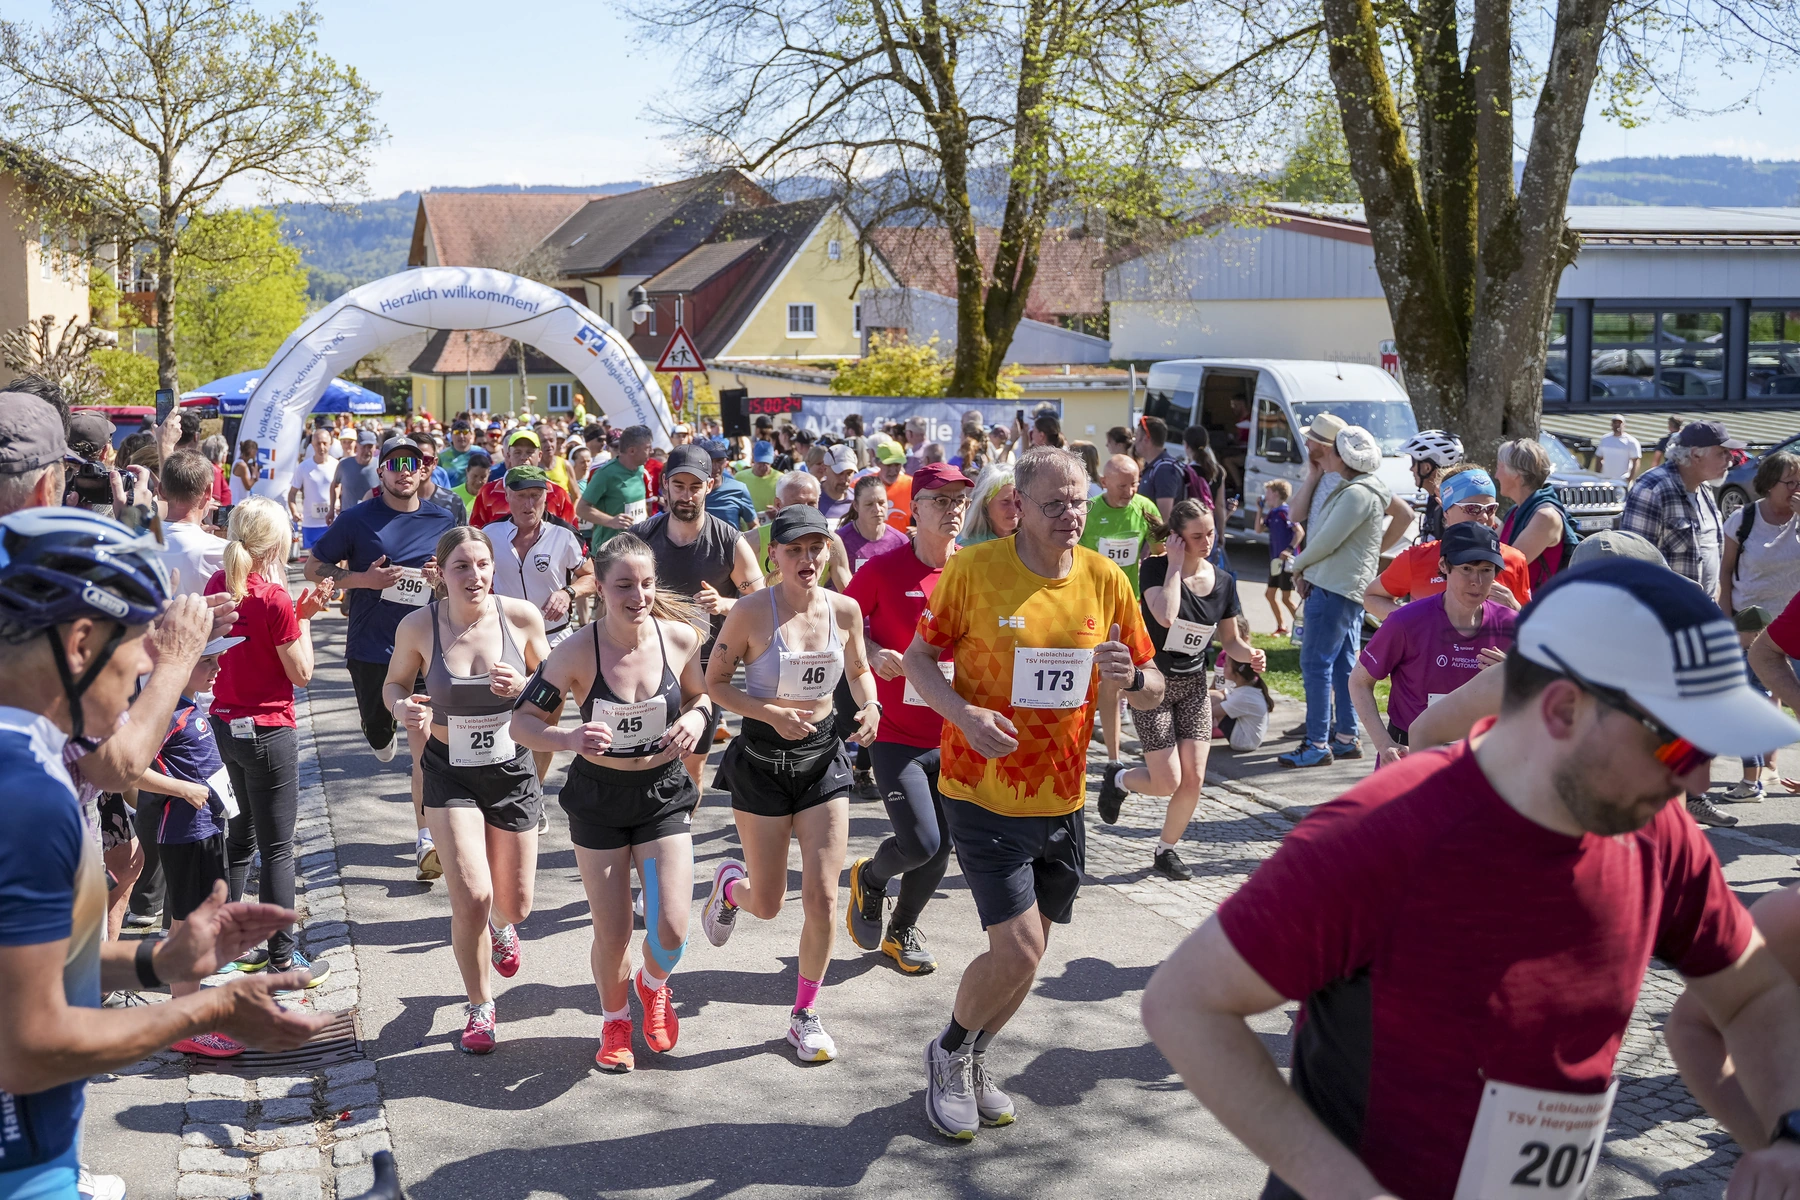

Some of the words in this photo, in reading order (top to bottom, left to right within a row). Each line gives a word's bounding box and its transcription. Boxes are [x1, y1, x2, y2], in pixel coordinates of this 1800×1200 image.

[380, 287, 437, 313] Herzlich
[442, 285, 540, 314] willkommen!
[610, 349, 644, 393] Volksbank
[601, 357, 648, 425] Allgäu-Obersch
[257, 388, 282, 439] Volksbank
[1108, 548, 1130, 559] 516
[396, 578, 423, 593] 396
[1184, 633, 1203, 646] 66
[1039, 658, 1084, 666] Hergensweiler
[801, 666, 826, 684] 46
[1034, 669, 1074, 692] 173
[612, 703, 648, 711] Leiblachlauf
[614, 706, 657, 717] Hergensweiler
[464, 716, 499, 724] Leiblachlauf
[467, 721, 507, 730] Hergensweiler
[616, 716, 643, 734] 45
[470, 730, 495, 749] 25
[1507, 1111, 1537, 1126] TSV
[1509, 1138, 1596, 1188] 201
